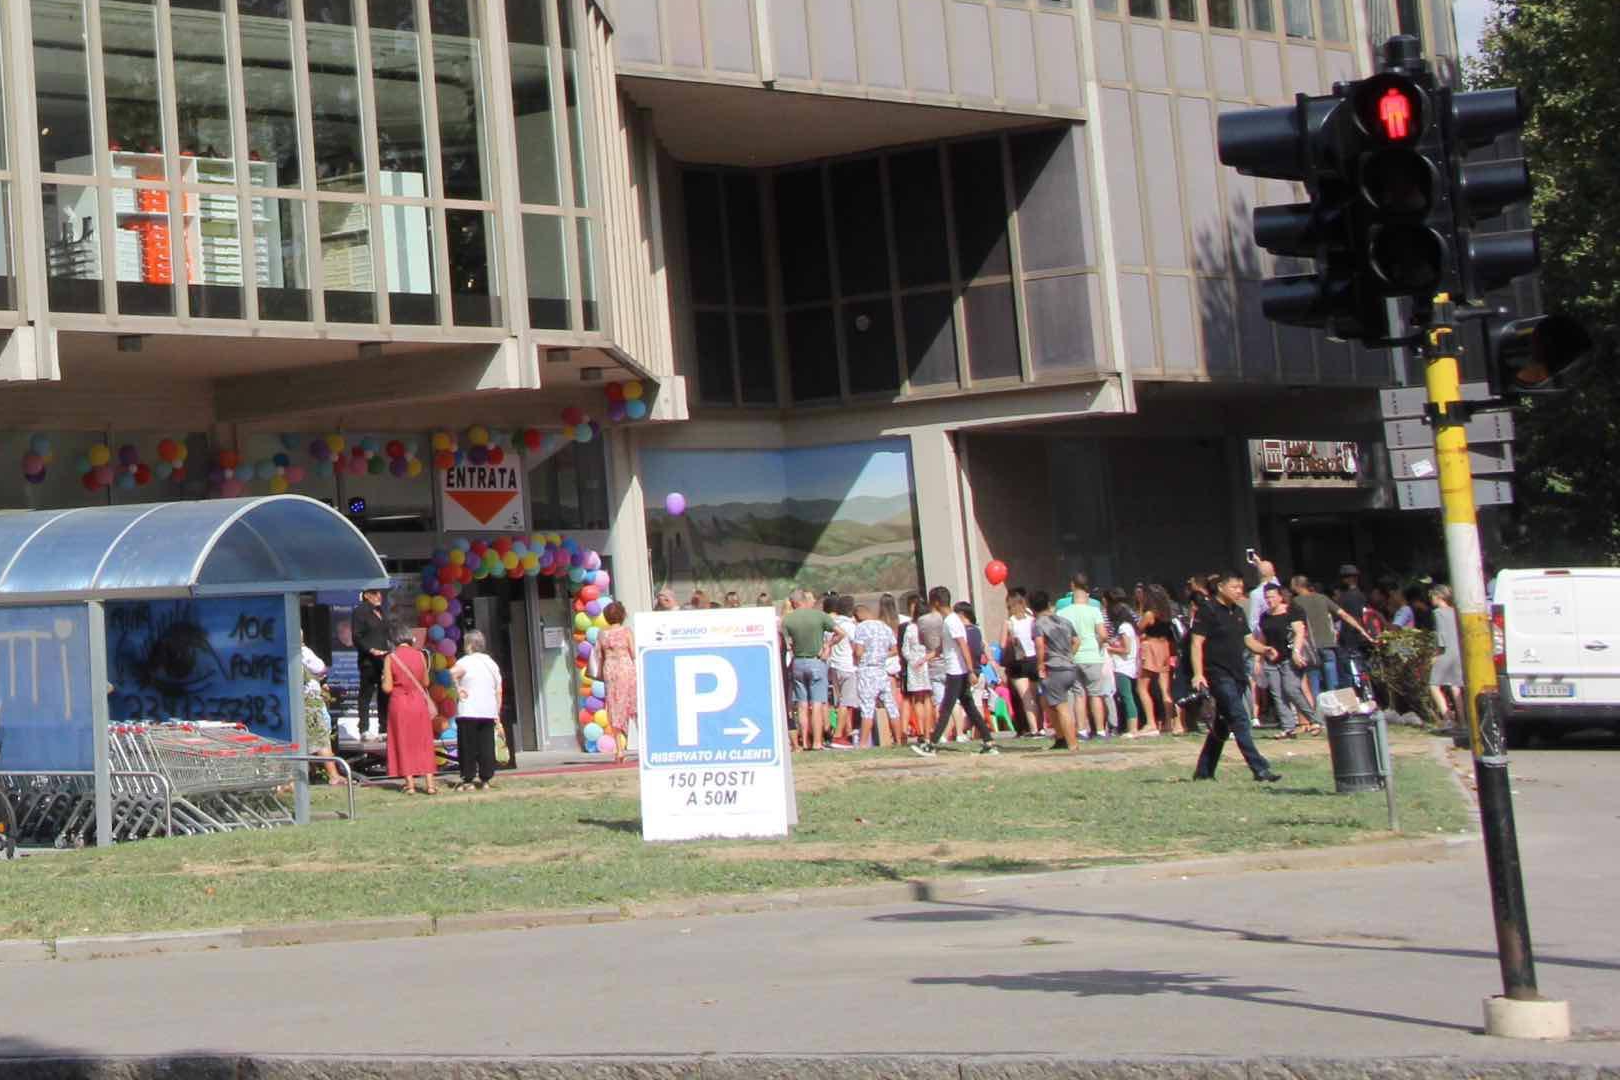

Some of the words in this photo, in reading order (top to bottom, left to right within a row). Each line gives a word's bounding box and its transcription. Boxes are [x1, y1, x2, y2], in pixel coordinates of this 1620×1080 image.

[446, 467, 517, 489] ENTRATA
[674, 654, 738, 747] P
[650, 750, 713, 763] RISERVATO
[715, 750, 728, 761] AI
[729, 748, 772, 761] CLIENTI
[668, 772, 697, 788] 150
[702, 771, 755, 787] POSTI
[686, 791, 698, 806] A
[704, 790, 738, 806] 50M
